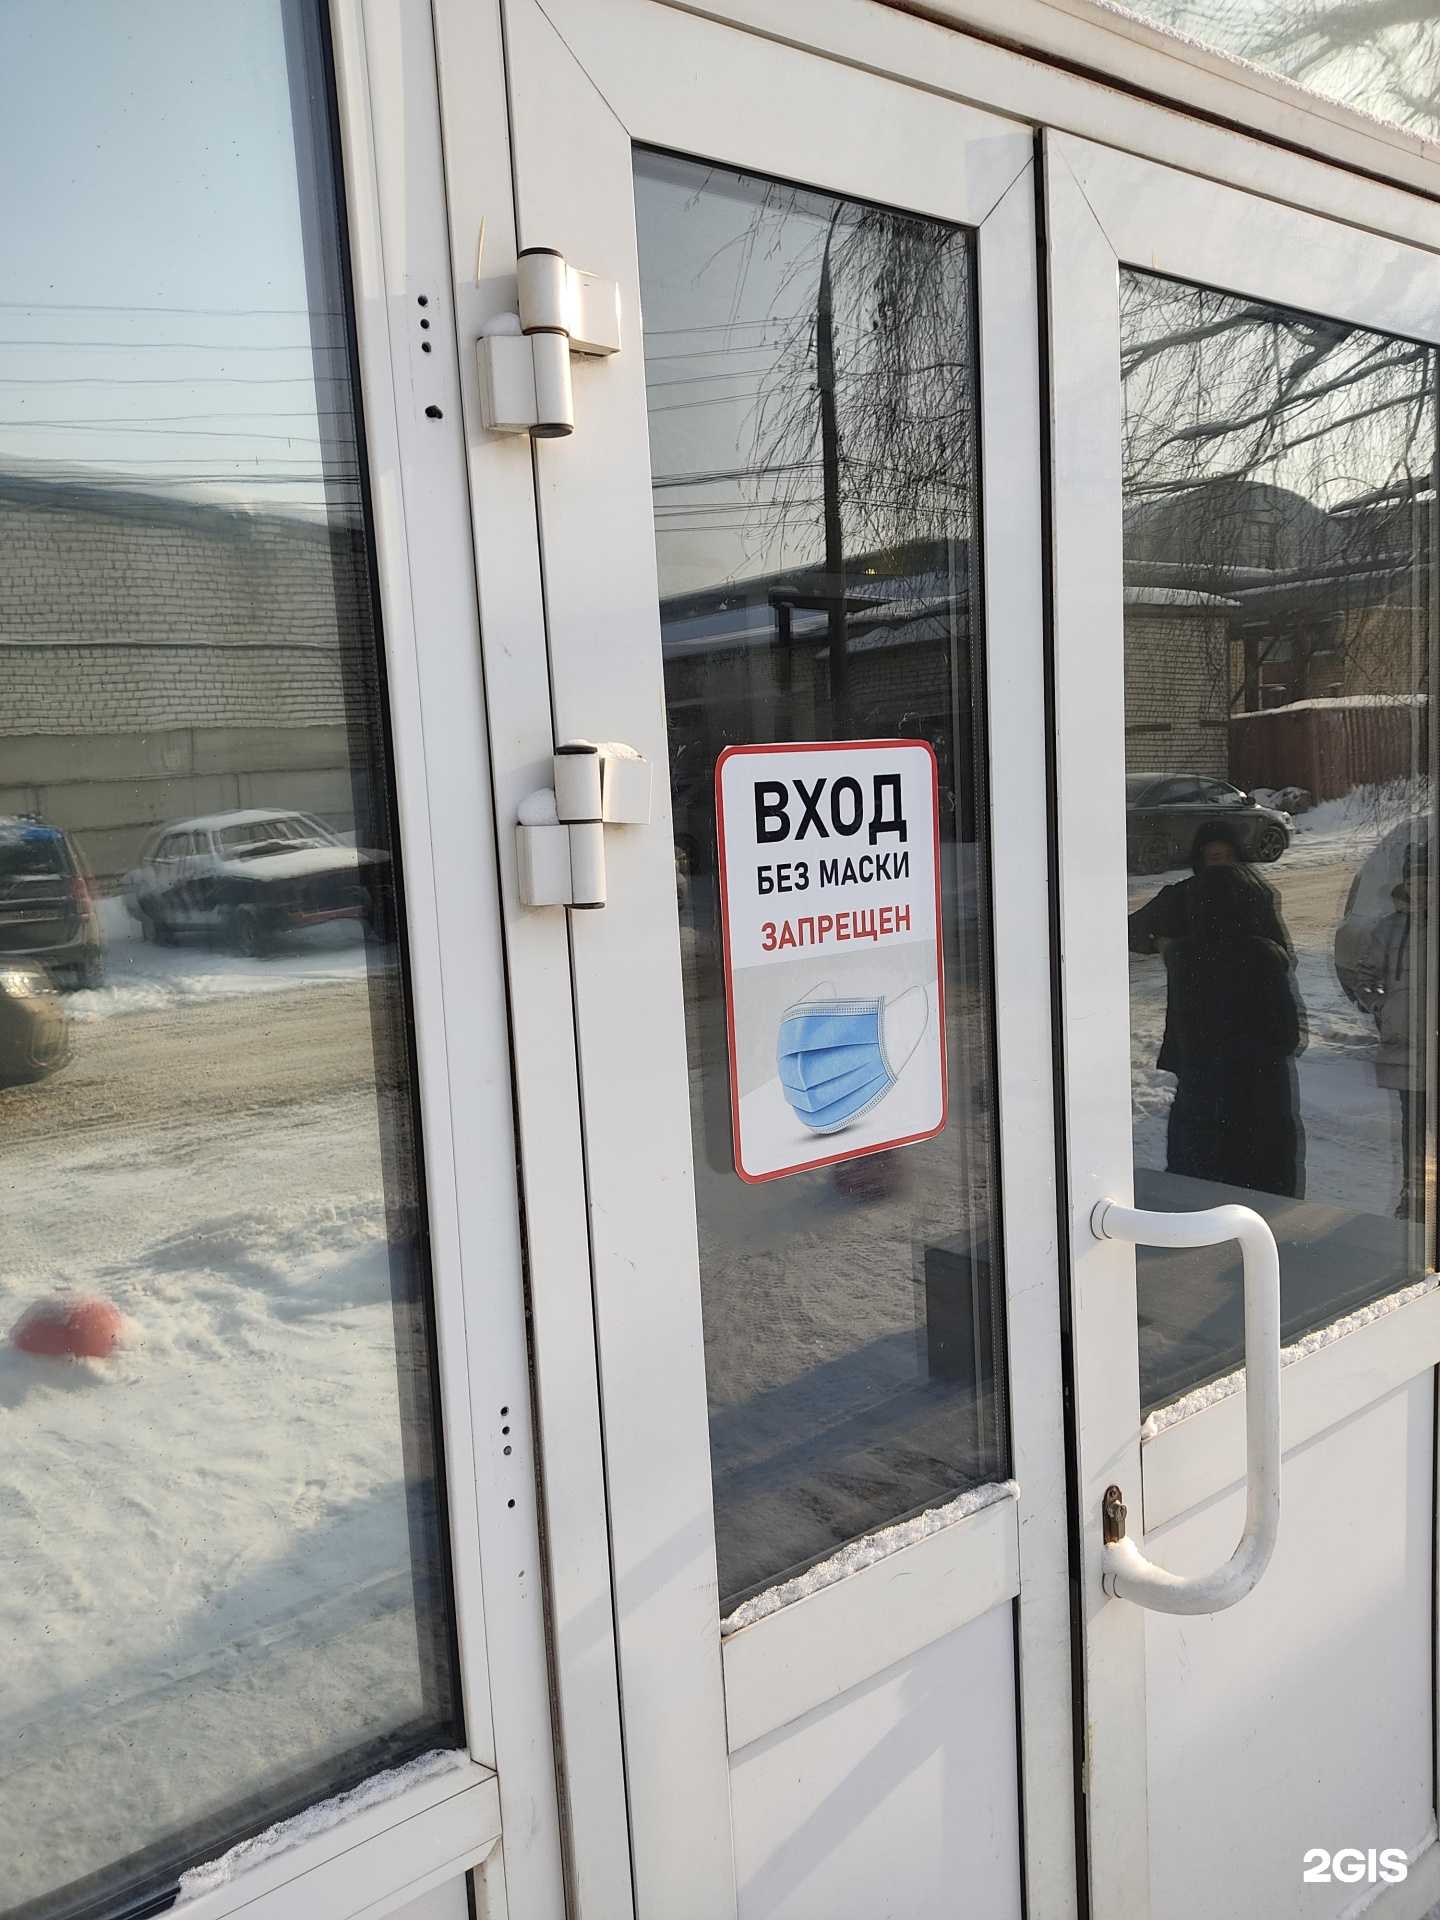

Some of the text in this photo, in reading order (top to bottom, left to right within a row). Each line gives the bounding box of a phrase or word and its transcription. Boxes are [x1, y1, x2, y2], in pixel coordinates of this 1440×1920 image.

[754, 774, 908, 845] ВХОД
[757, 851, 910, 895] БЕЗ МАСКИ
[761, 905, 911, 951] ЗАПРЕЩЕН
